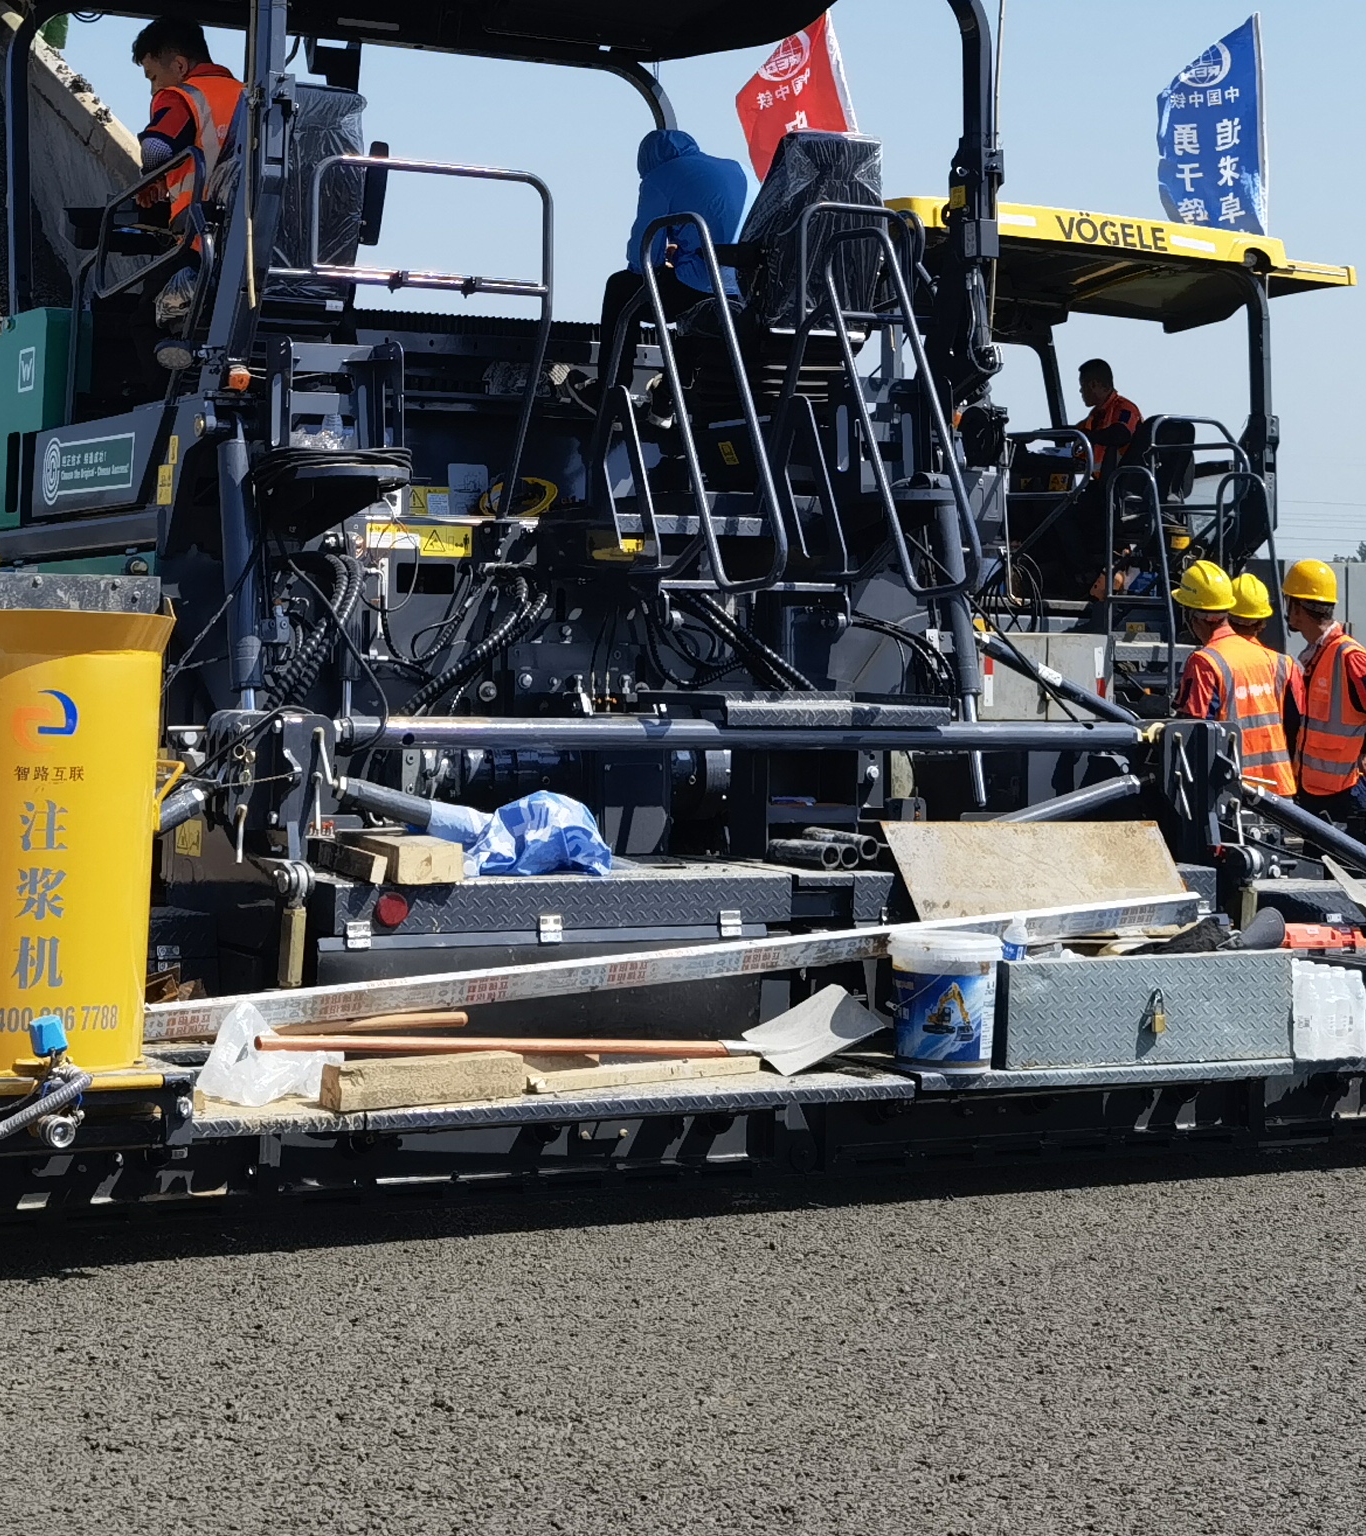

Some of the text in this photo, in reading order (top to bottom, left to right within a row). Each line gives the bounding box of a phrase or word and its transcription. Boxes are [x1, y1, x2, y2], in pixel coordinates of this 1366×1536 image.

[1055, 211, 1168, 252] VÖGELE
[13, 765, 84, 782] 智路互联
[11, 799, 68, 990] 注浆机
[81, 1004, 118, 1031] 7788
